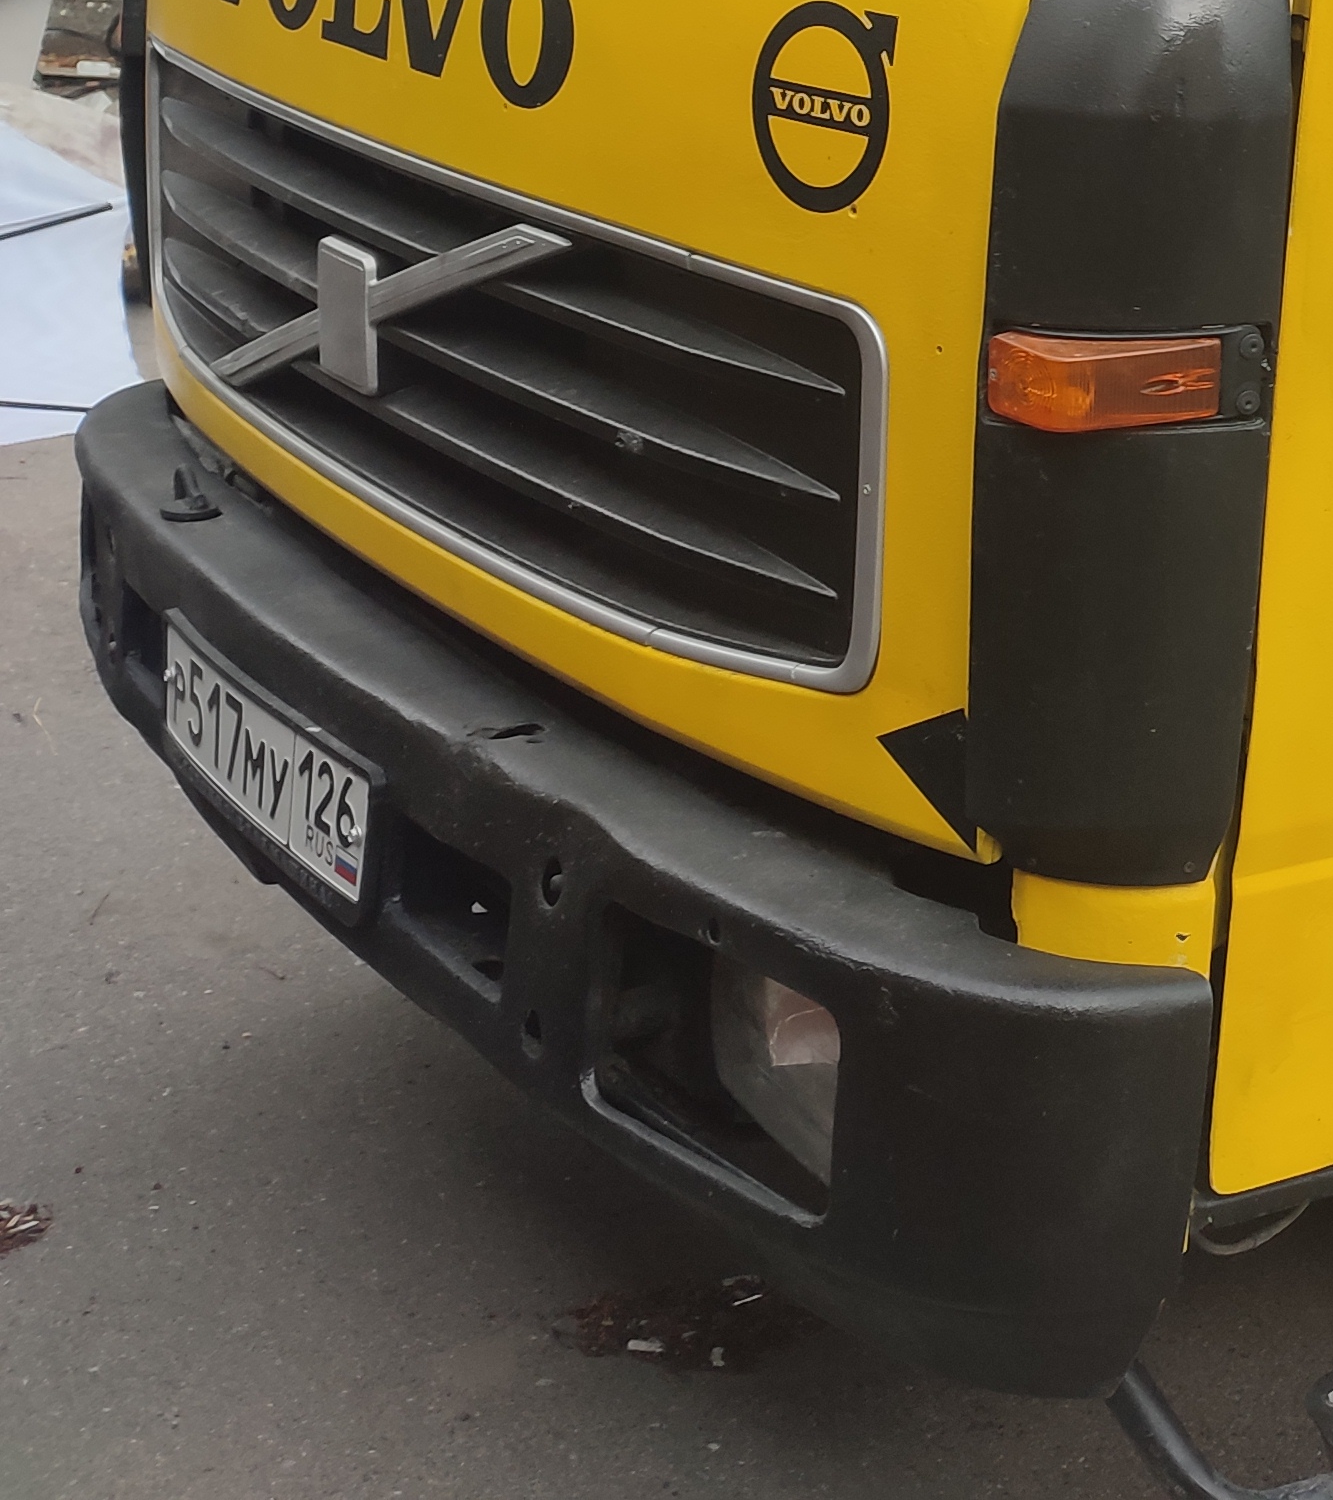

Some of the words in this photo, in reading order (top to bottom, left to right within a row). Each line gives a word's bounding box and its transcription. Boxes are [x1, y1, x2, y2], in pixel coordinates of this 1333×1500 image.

[768, 84, 873, 130] VOLVO
[298, 749, 357, 849] 126
[304, 823, 335, 867] RUS
